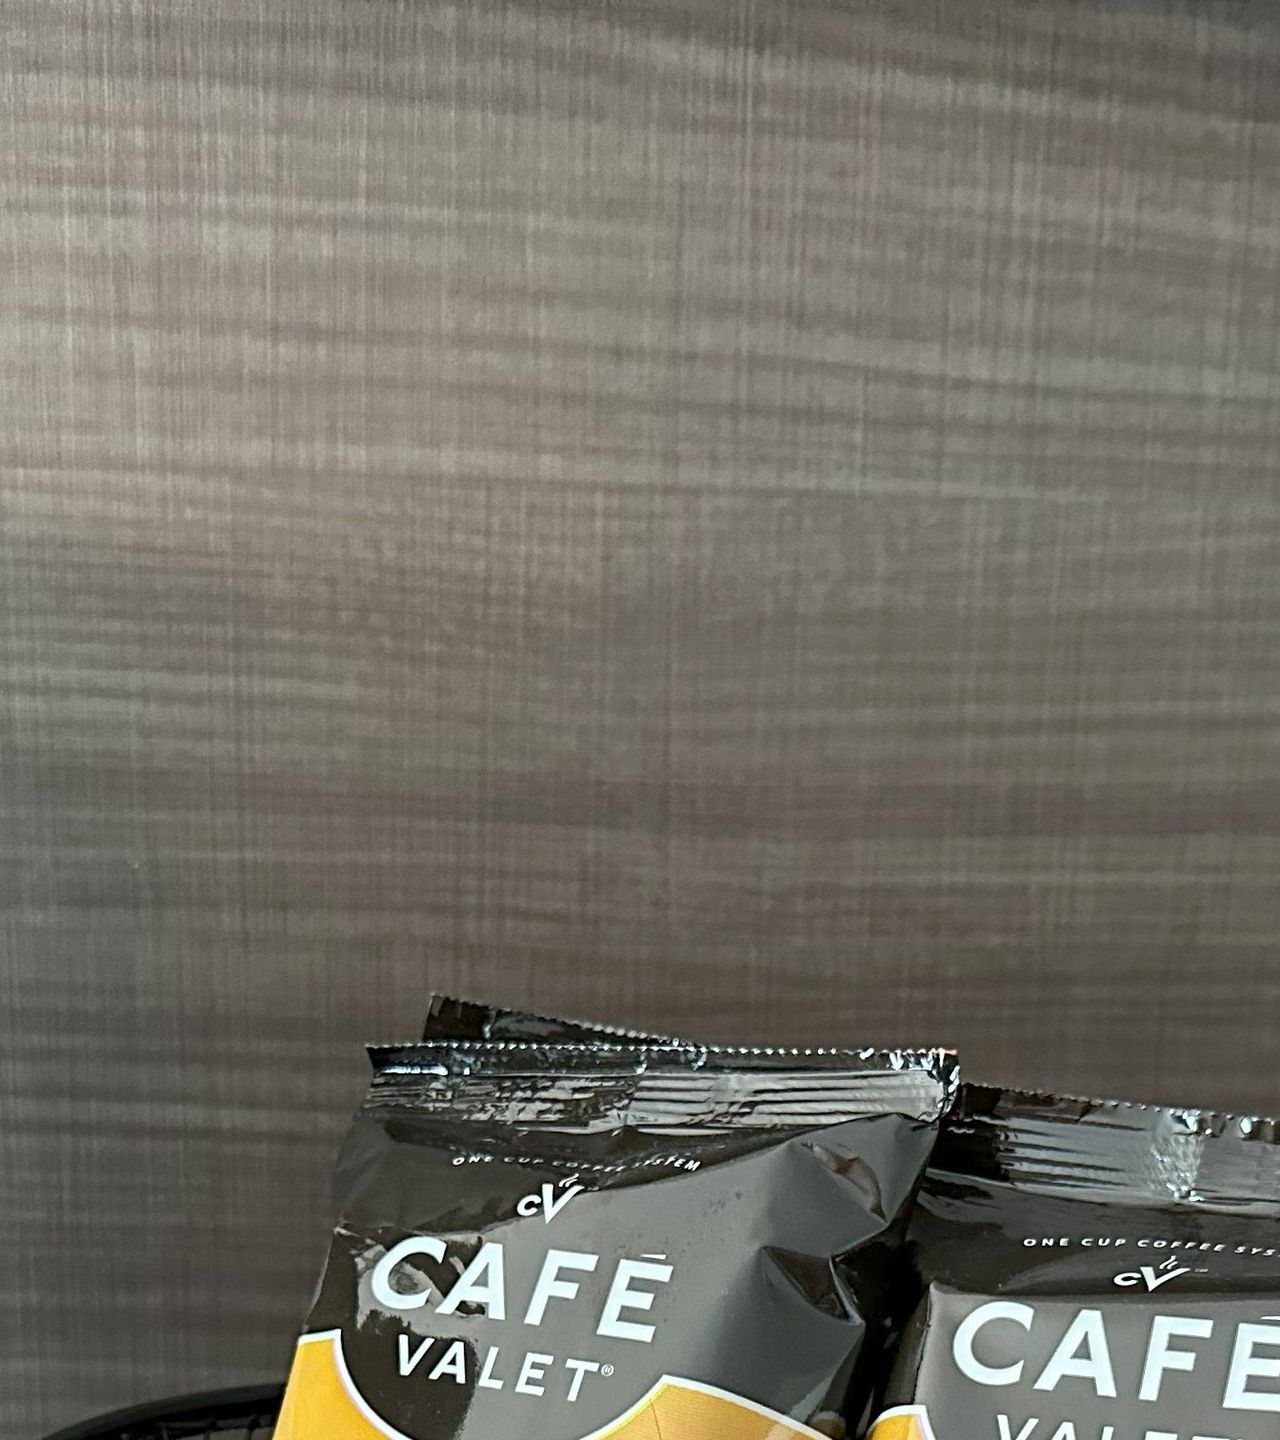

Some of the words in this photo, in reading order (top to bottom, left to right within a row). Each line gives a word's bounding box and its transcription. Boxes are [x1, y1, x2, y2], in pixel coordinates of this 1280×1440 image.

[1022, 1237, 1070, 1248] ONE
[1080, 1237, 1127, 1248] CUP
[1136, 1238, 1227, 1252] COFFEE
[371, 1235, 675, 1343] CAFÉ
